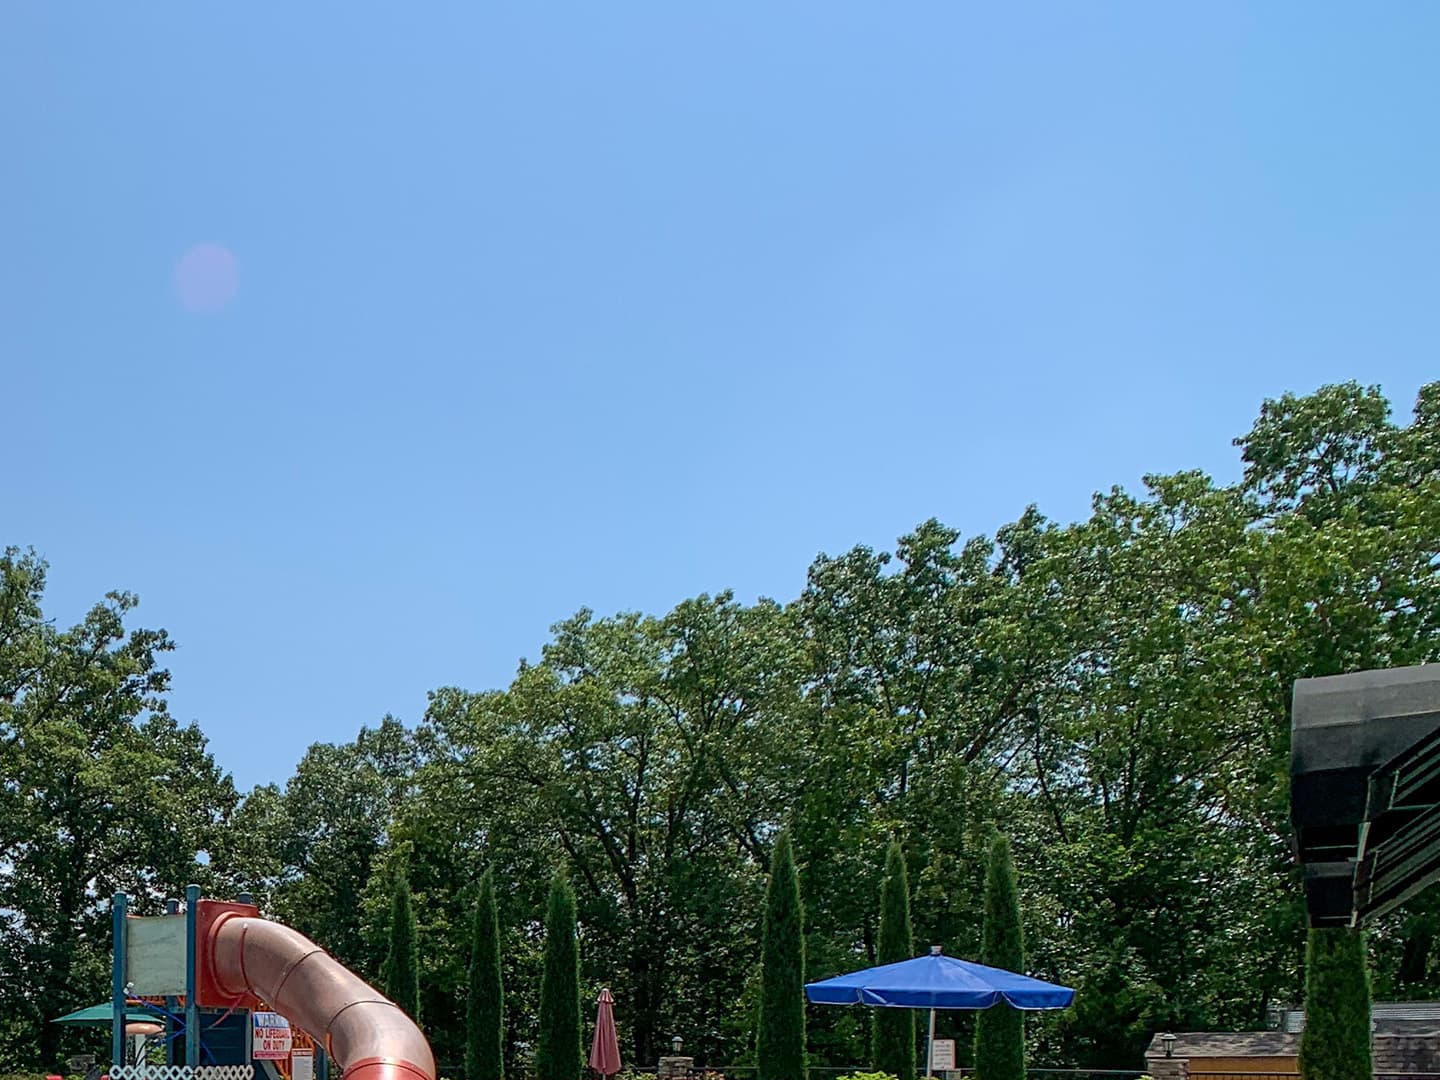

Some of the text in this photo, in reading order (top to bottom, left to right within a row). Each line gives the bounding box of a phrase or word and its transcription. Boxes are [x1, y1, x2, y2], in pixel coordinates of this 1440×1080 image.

[255, 1028, 264, 1039] NO
[263, 1039, 285, 1050] ON DUTY
